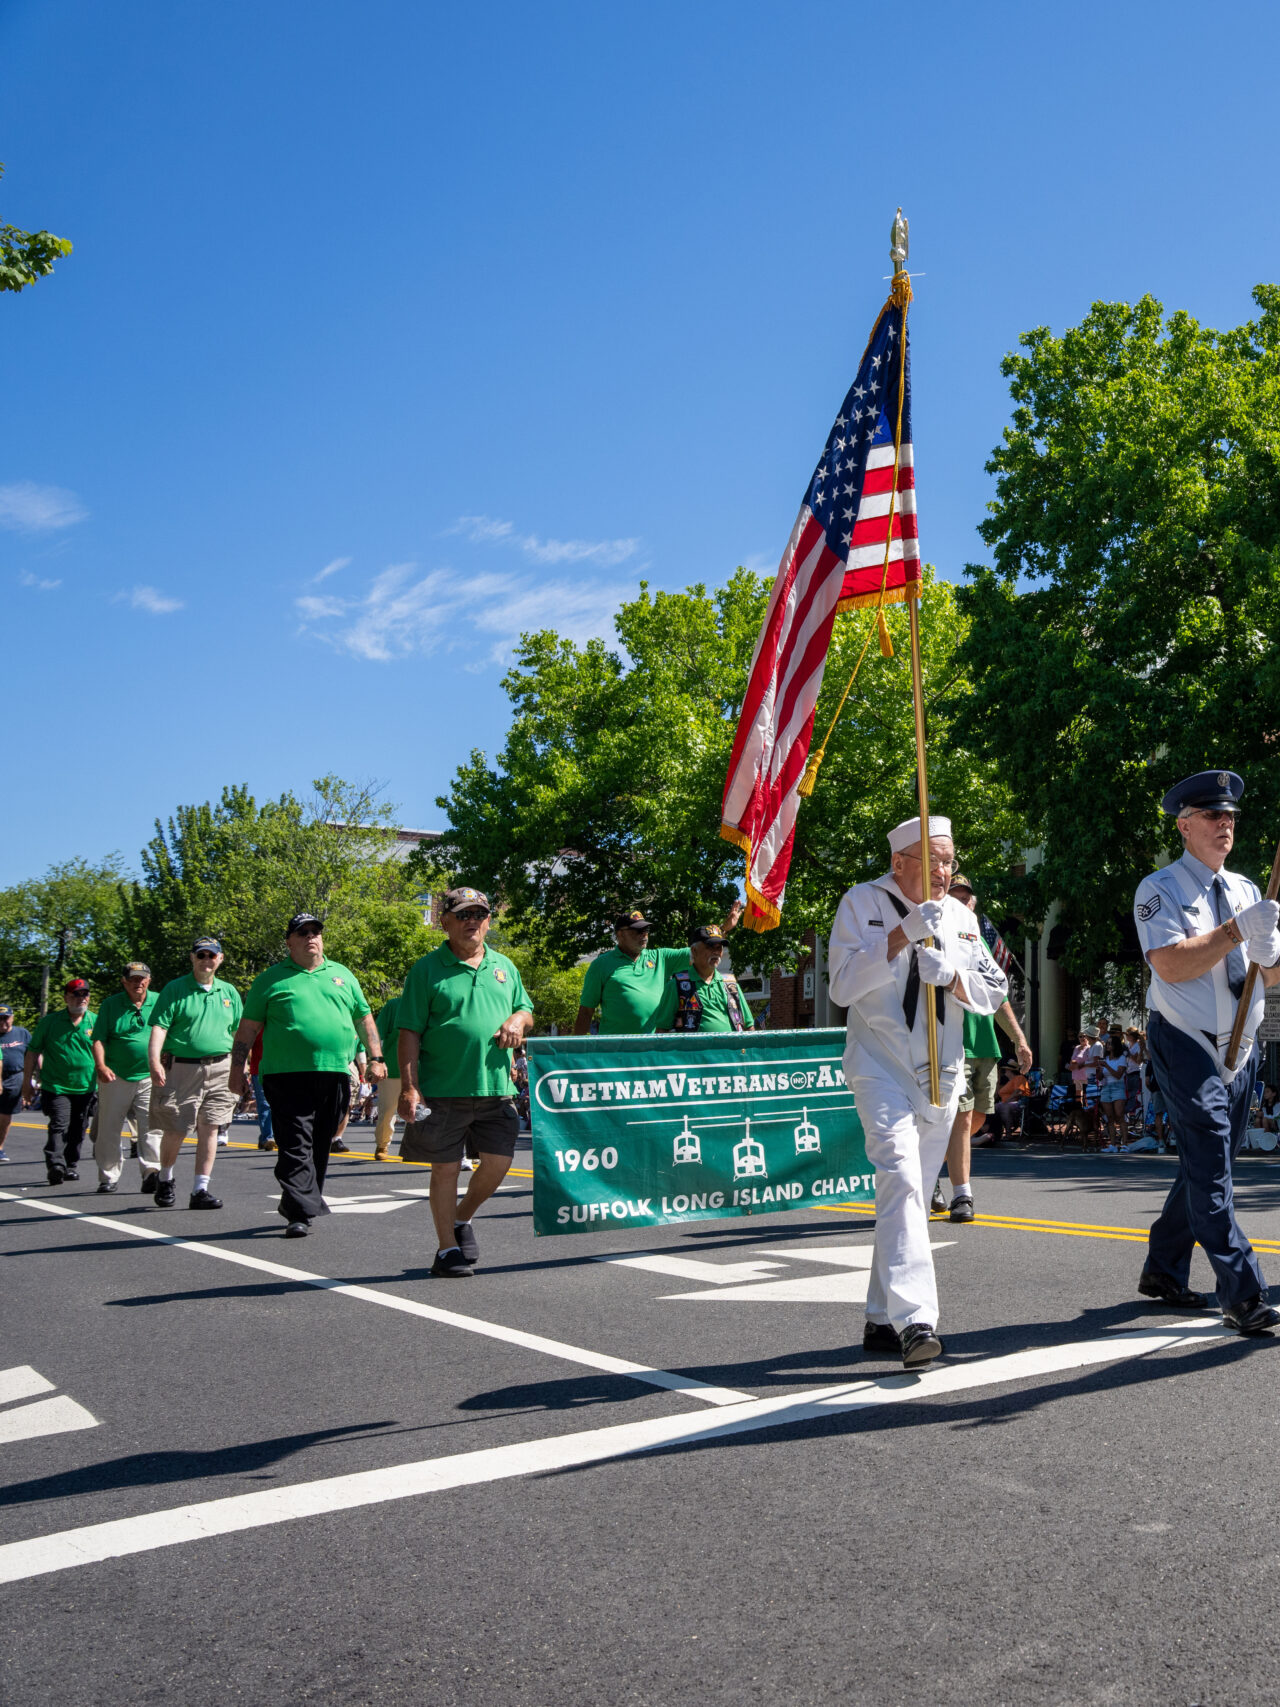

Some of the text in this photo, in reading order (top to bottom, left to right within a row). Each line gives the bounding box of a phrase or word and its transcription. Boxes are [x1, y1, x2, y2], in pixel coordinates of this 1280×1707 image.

[548, 1078, 668, 1103] VIETNAM
[666, 1072, 790, 1096] VETERANS
[555, 1146, 619, 1172] 1960
[557, 1198, 654, 1224] SUFFOLK
[662, 1191, 724, 1214] LONG
[733, 1182, 804, 1206] ISLAND
